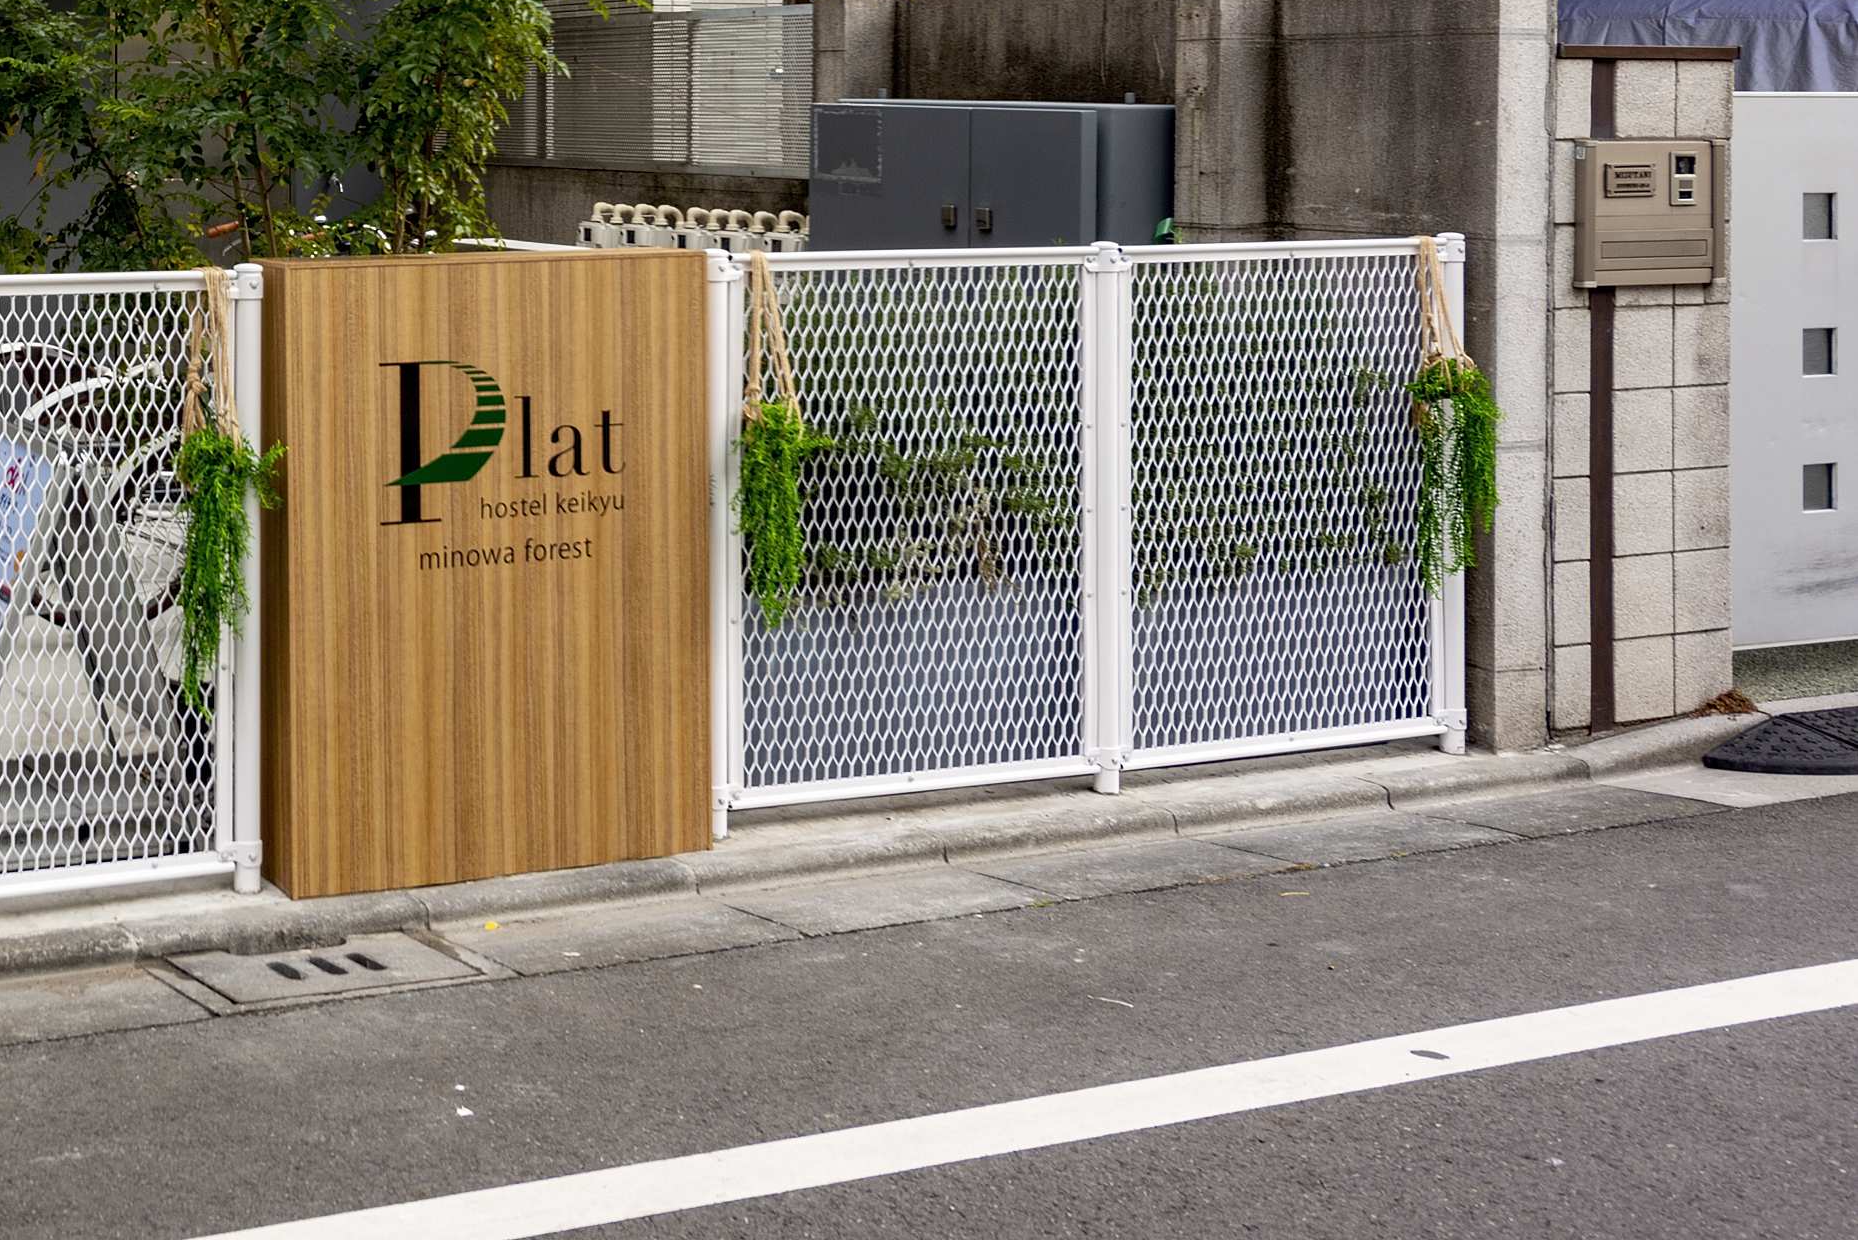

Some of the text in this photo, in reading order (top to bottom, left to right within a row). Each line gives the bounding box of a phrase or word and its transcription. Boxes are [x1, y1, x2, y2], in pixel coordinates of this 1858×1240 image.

[378, 360, 626, 526] Plat
[480, 490, 625, 519] hostel keikyu
[419, 536, 593, 571] minowa forest
